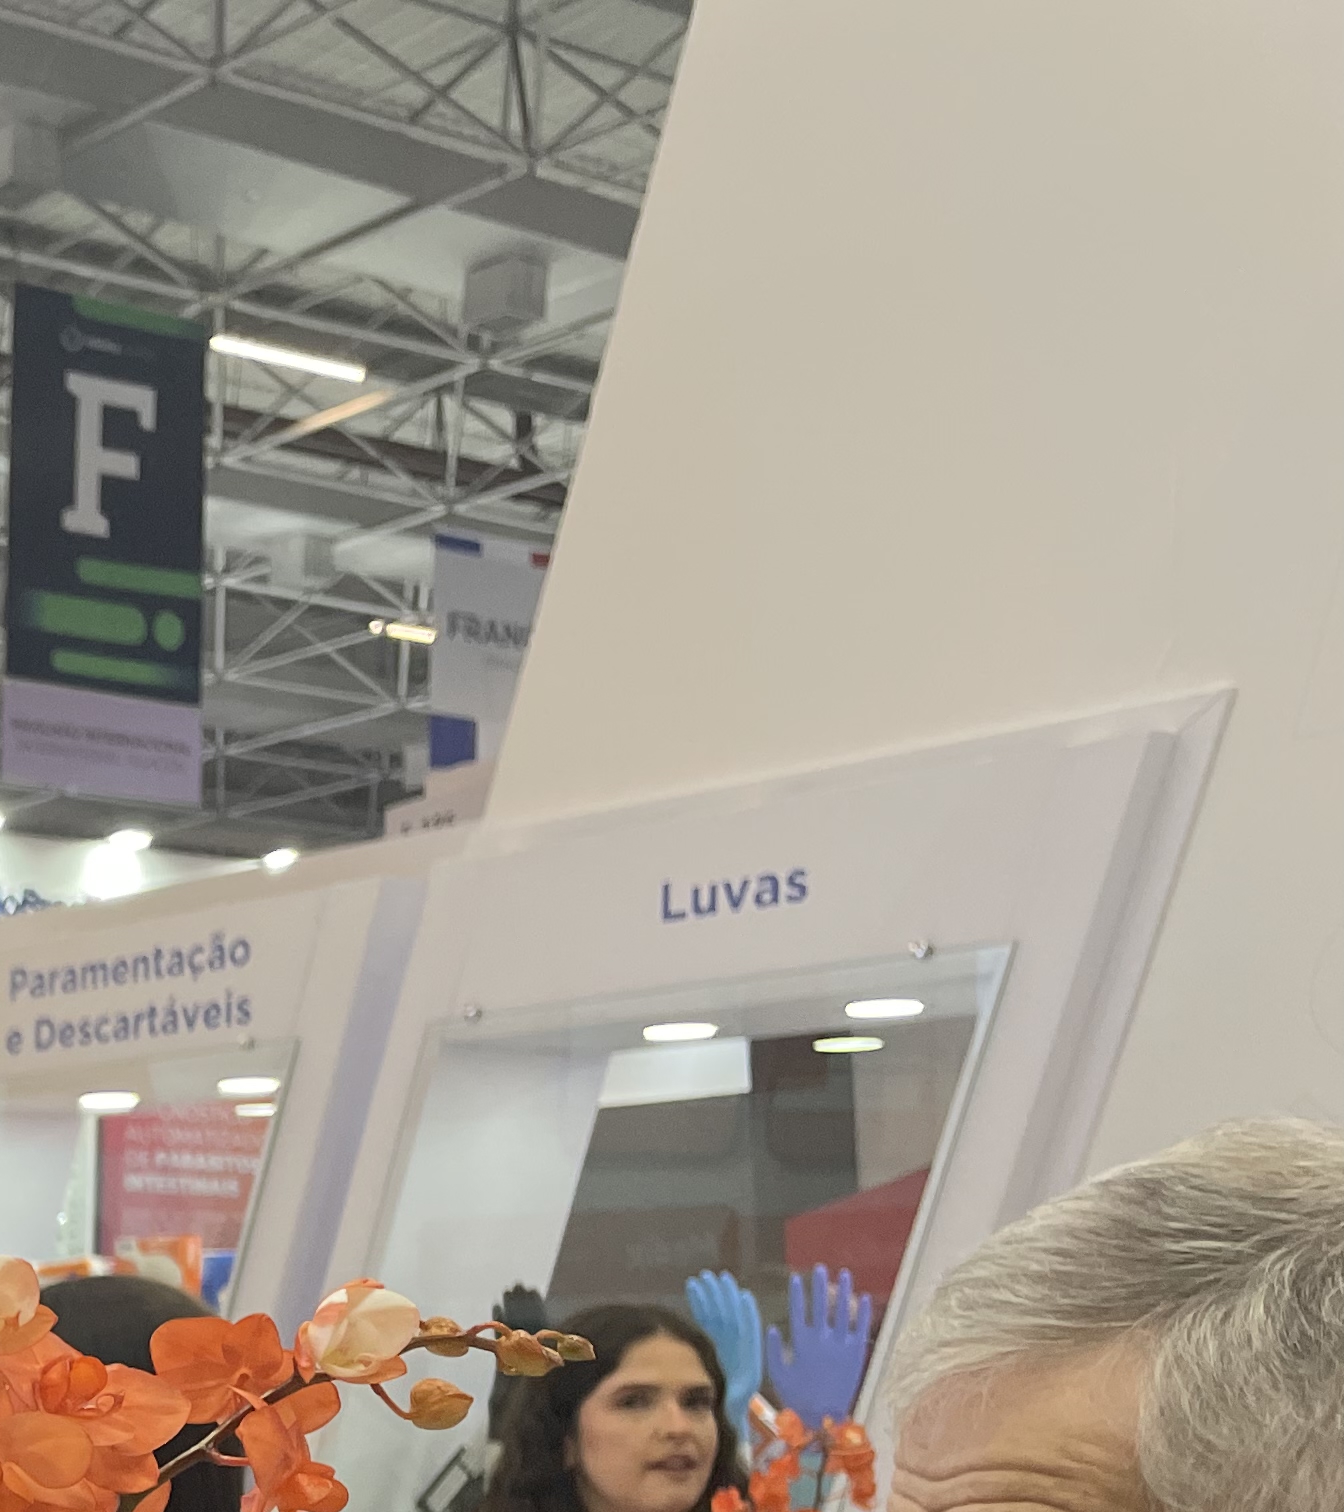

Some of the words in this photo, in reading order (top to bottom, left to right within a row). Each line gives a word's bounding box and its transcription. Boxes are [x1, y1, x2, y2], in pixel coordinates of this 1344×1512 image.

[61, 369, 157, 538] F
[662, 868, 808, 921] Luvas
[9, 931, 251, 1000] Paramentação
[6, 1027, 23, 1055] e
[34, 988, 252, 1052] Descartáveis
